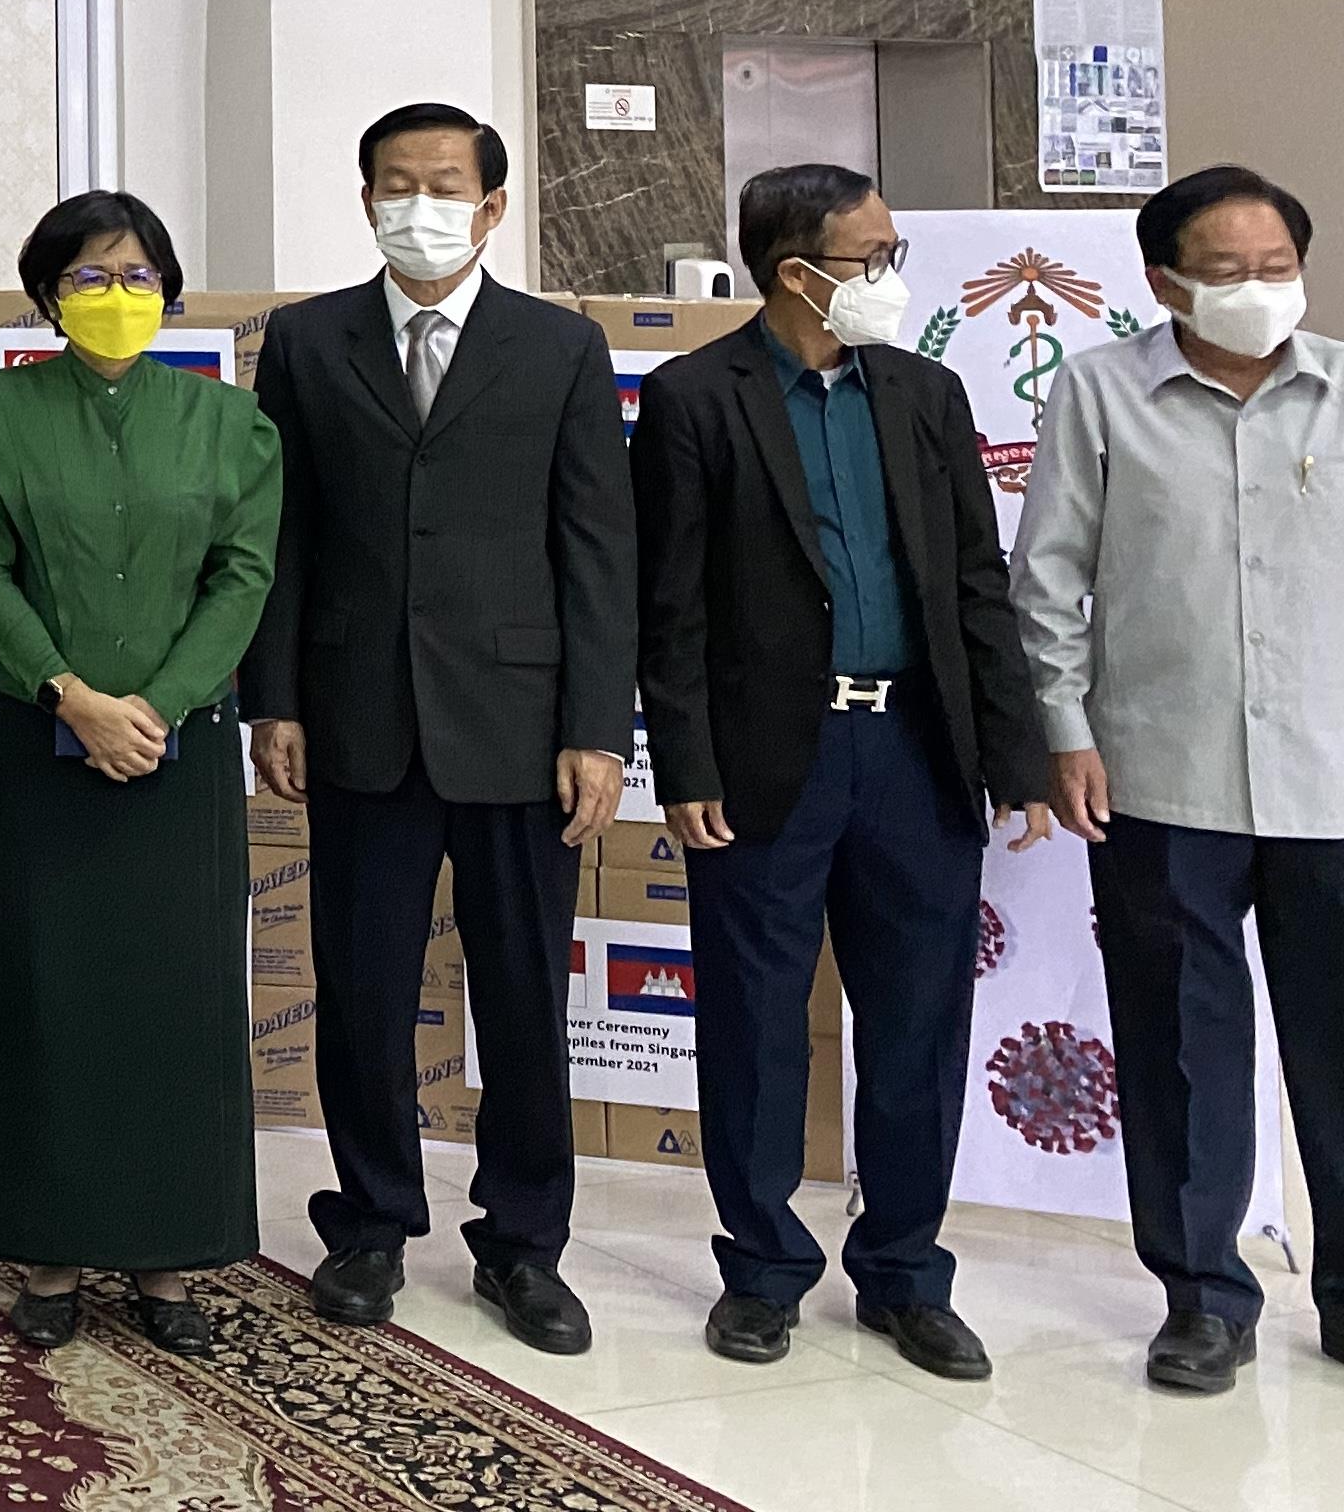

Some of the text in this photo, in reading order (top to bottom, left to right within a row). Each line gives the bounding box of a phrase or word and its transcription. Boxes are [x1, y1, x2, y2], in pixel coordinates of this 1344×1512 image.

[624, 777, 646, 788] 021
[596, 1020, 670, 1040] Ceremony
[572, 1036, 696, 1060] plies from Singap
[569, 1056, 658, 1073] cember 2021
